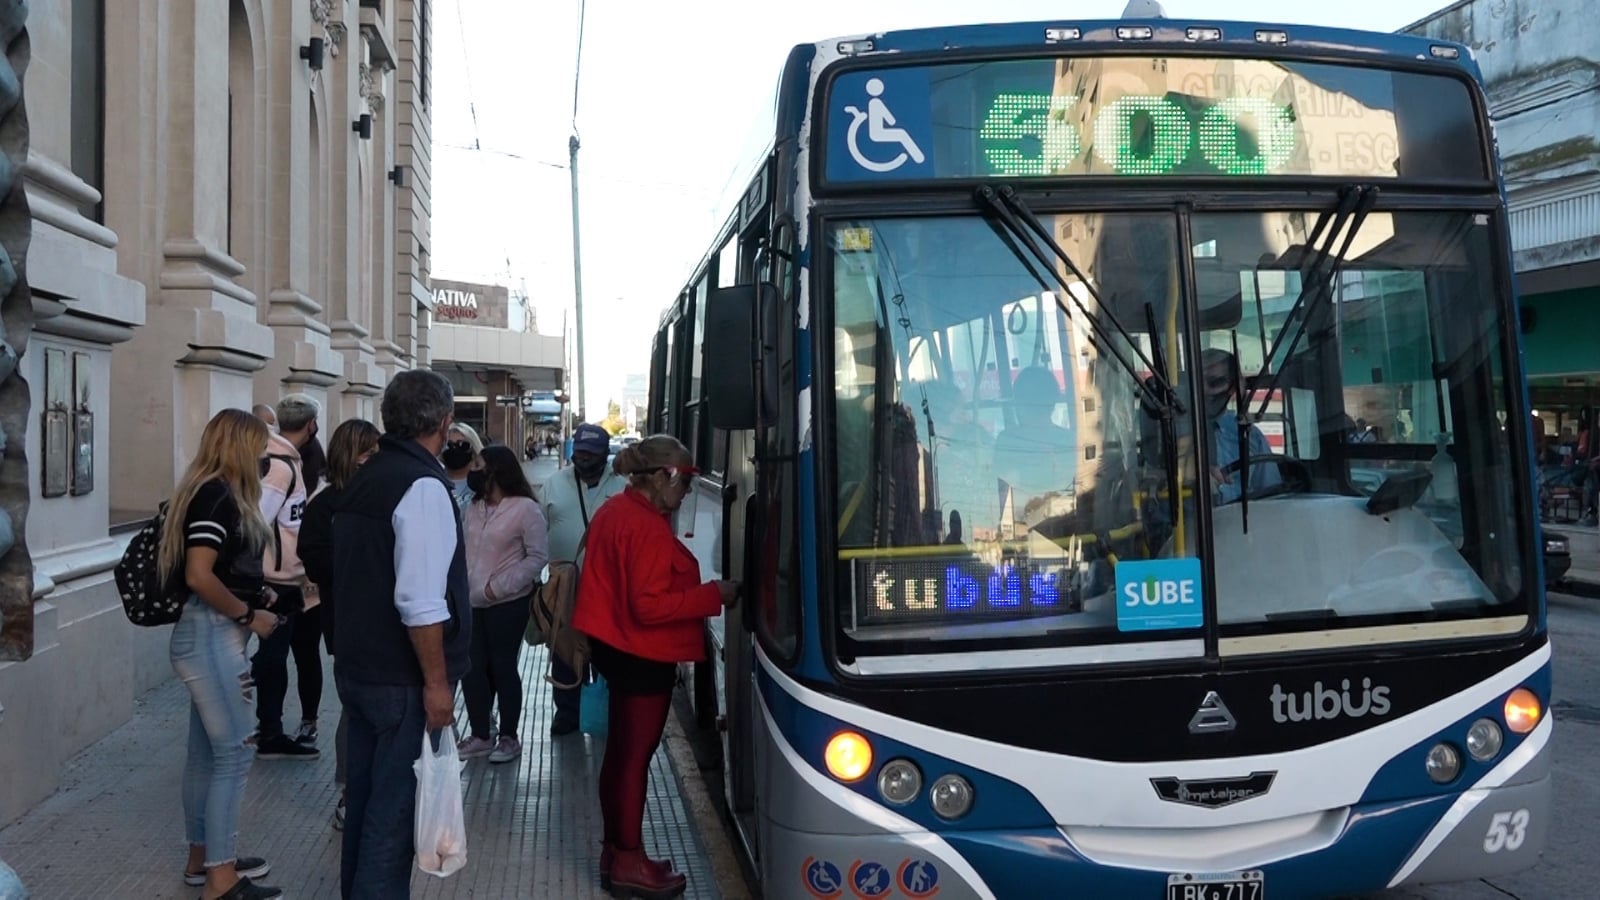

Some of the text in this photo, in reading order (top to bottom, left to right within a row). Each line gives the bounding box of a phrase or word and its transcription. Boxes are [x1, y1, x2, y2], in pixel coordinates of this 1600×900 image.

[980, 93, 1297, 175] 500
[1124, 579, 1195, 607] SUBE
[1482, 808, 1530, 854] 53
